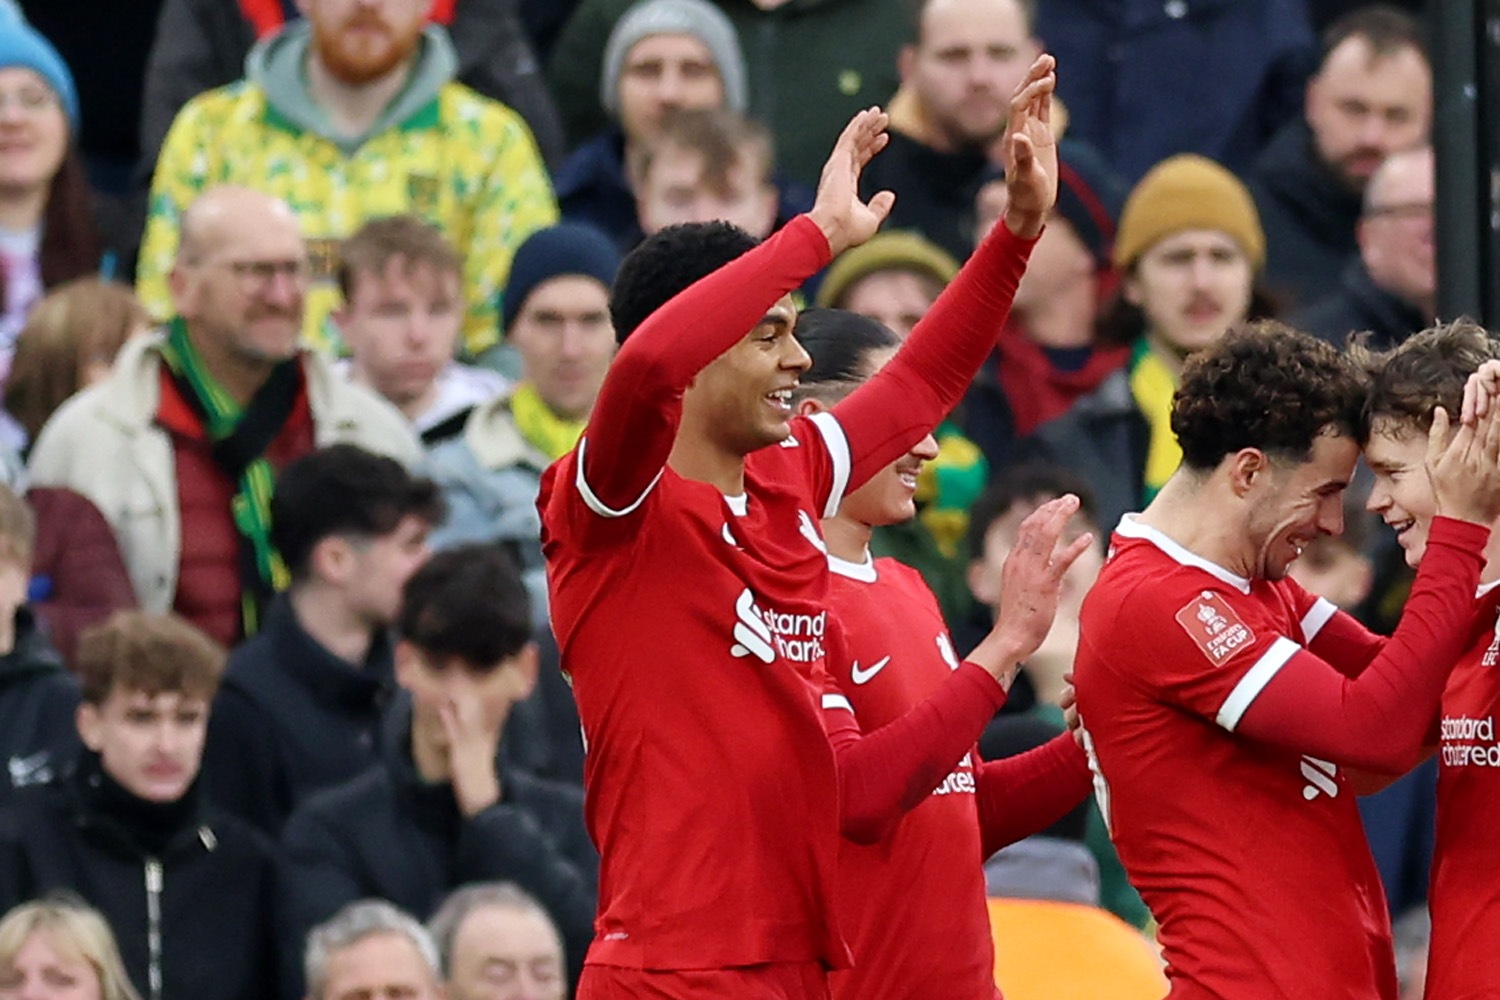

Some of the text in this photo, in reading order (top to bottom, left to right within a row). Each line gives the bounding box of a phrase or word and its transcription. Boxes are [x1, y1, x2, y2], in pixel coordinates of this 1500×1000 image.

[1212, 628, 1248, 659] FA CUP
[1480, 651, 1500, 667] LFC
